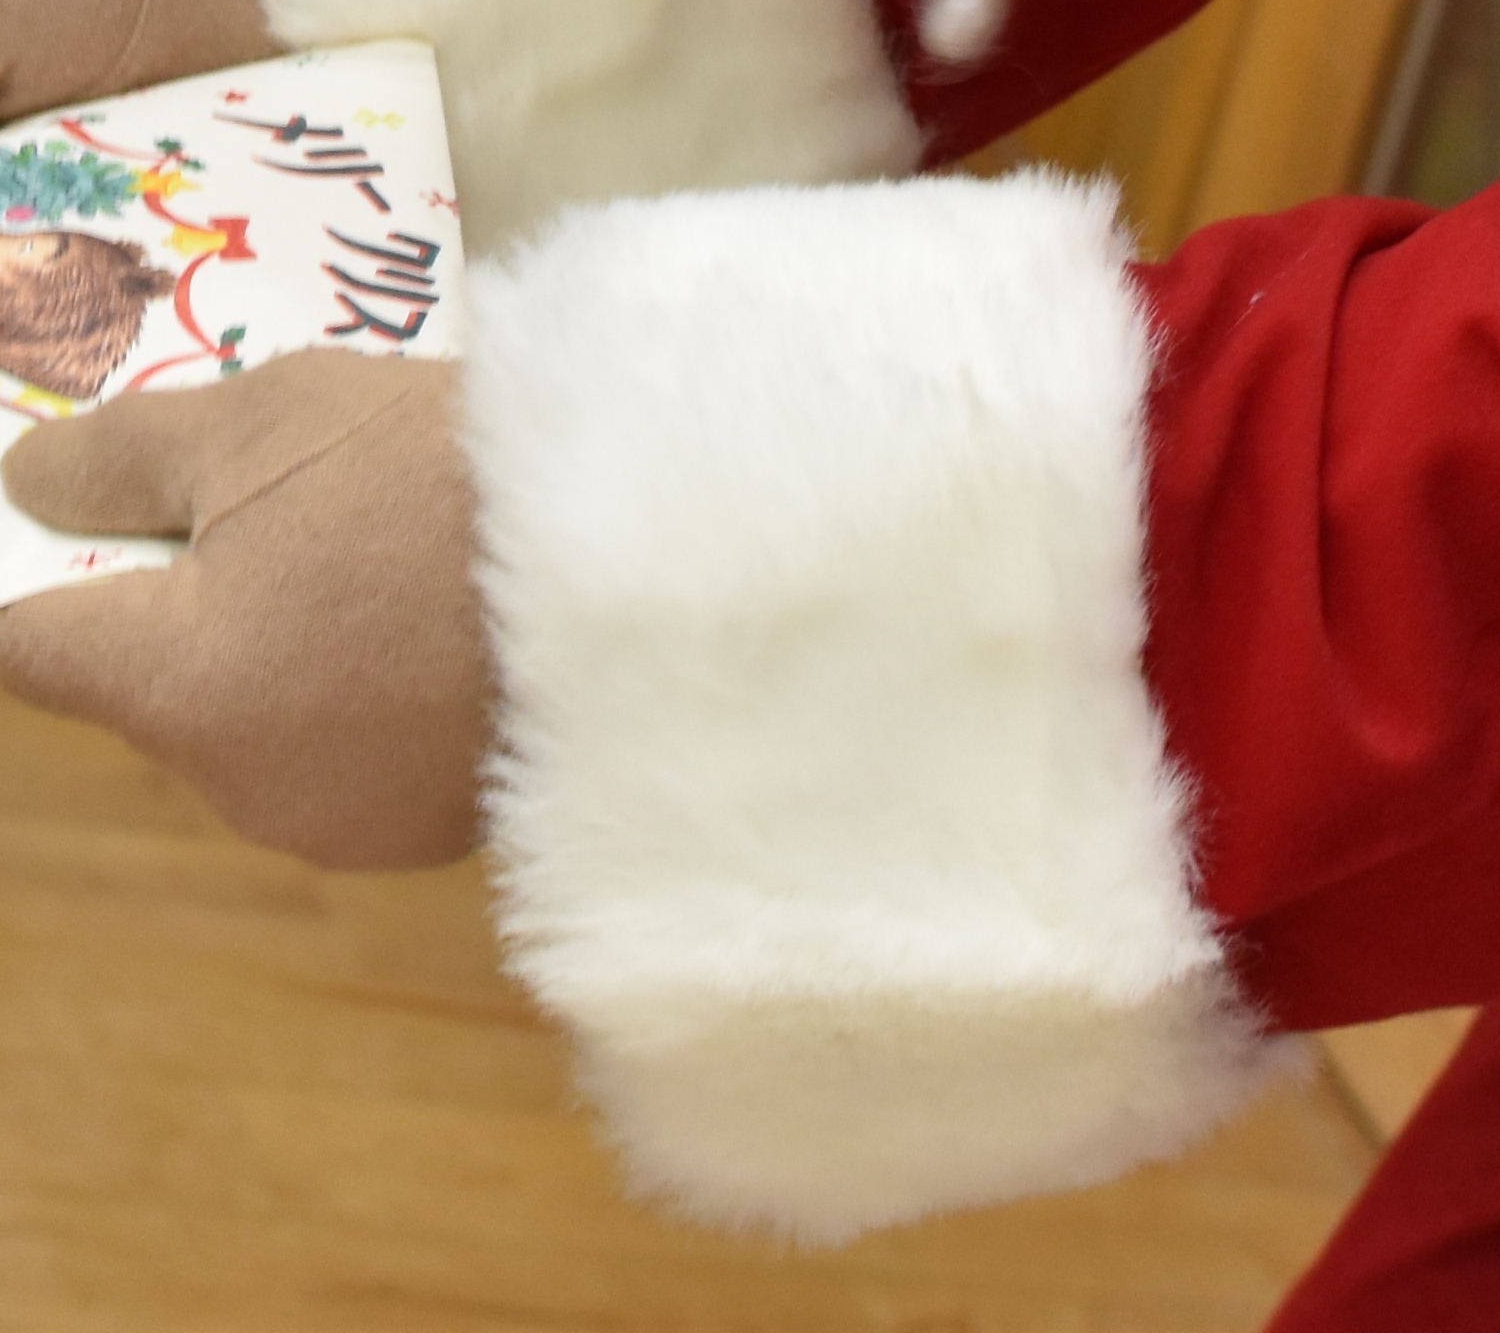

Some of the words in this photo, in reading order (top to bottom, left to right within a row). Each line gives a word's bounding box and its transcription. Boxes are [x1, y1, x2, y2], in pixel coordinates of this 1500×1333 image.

[212, 113, 442, 357] メリークリス
